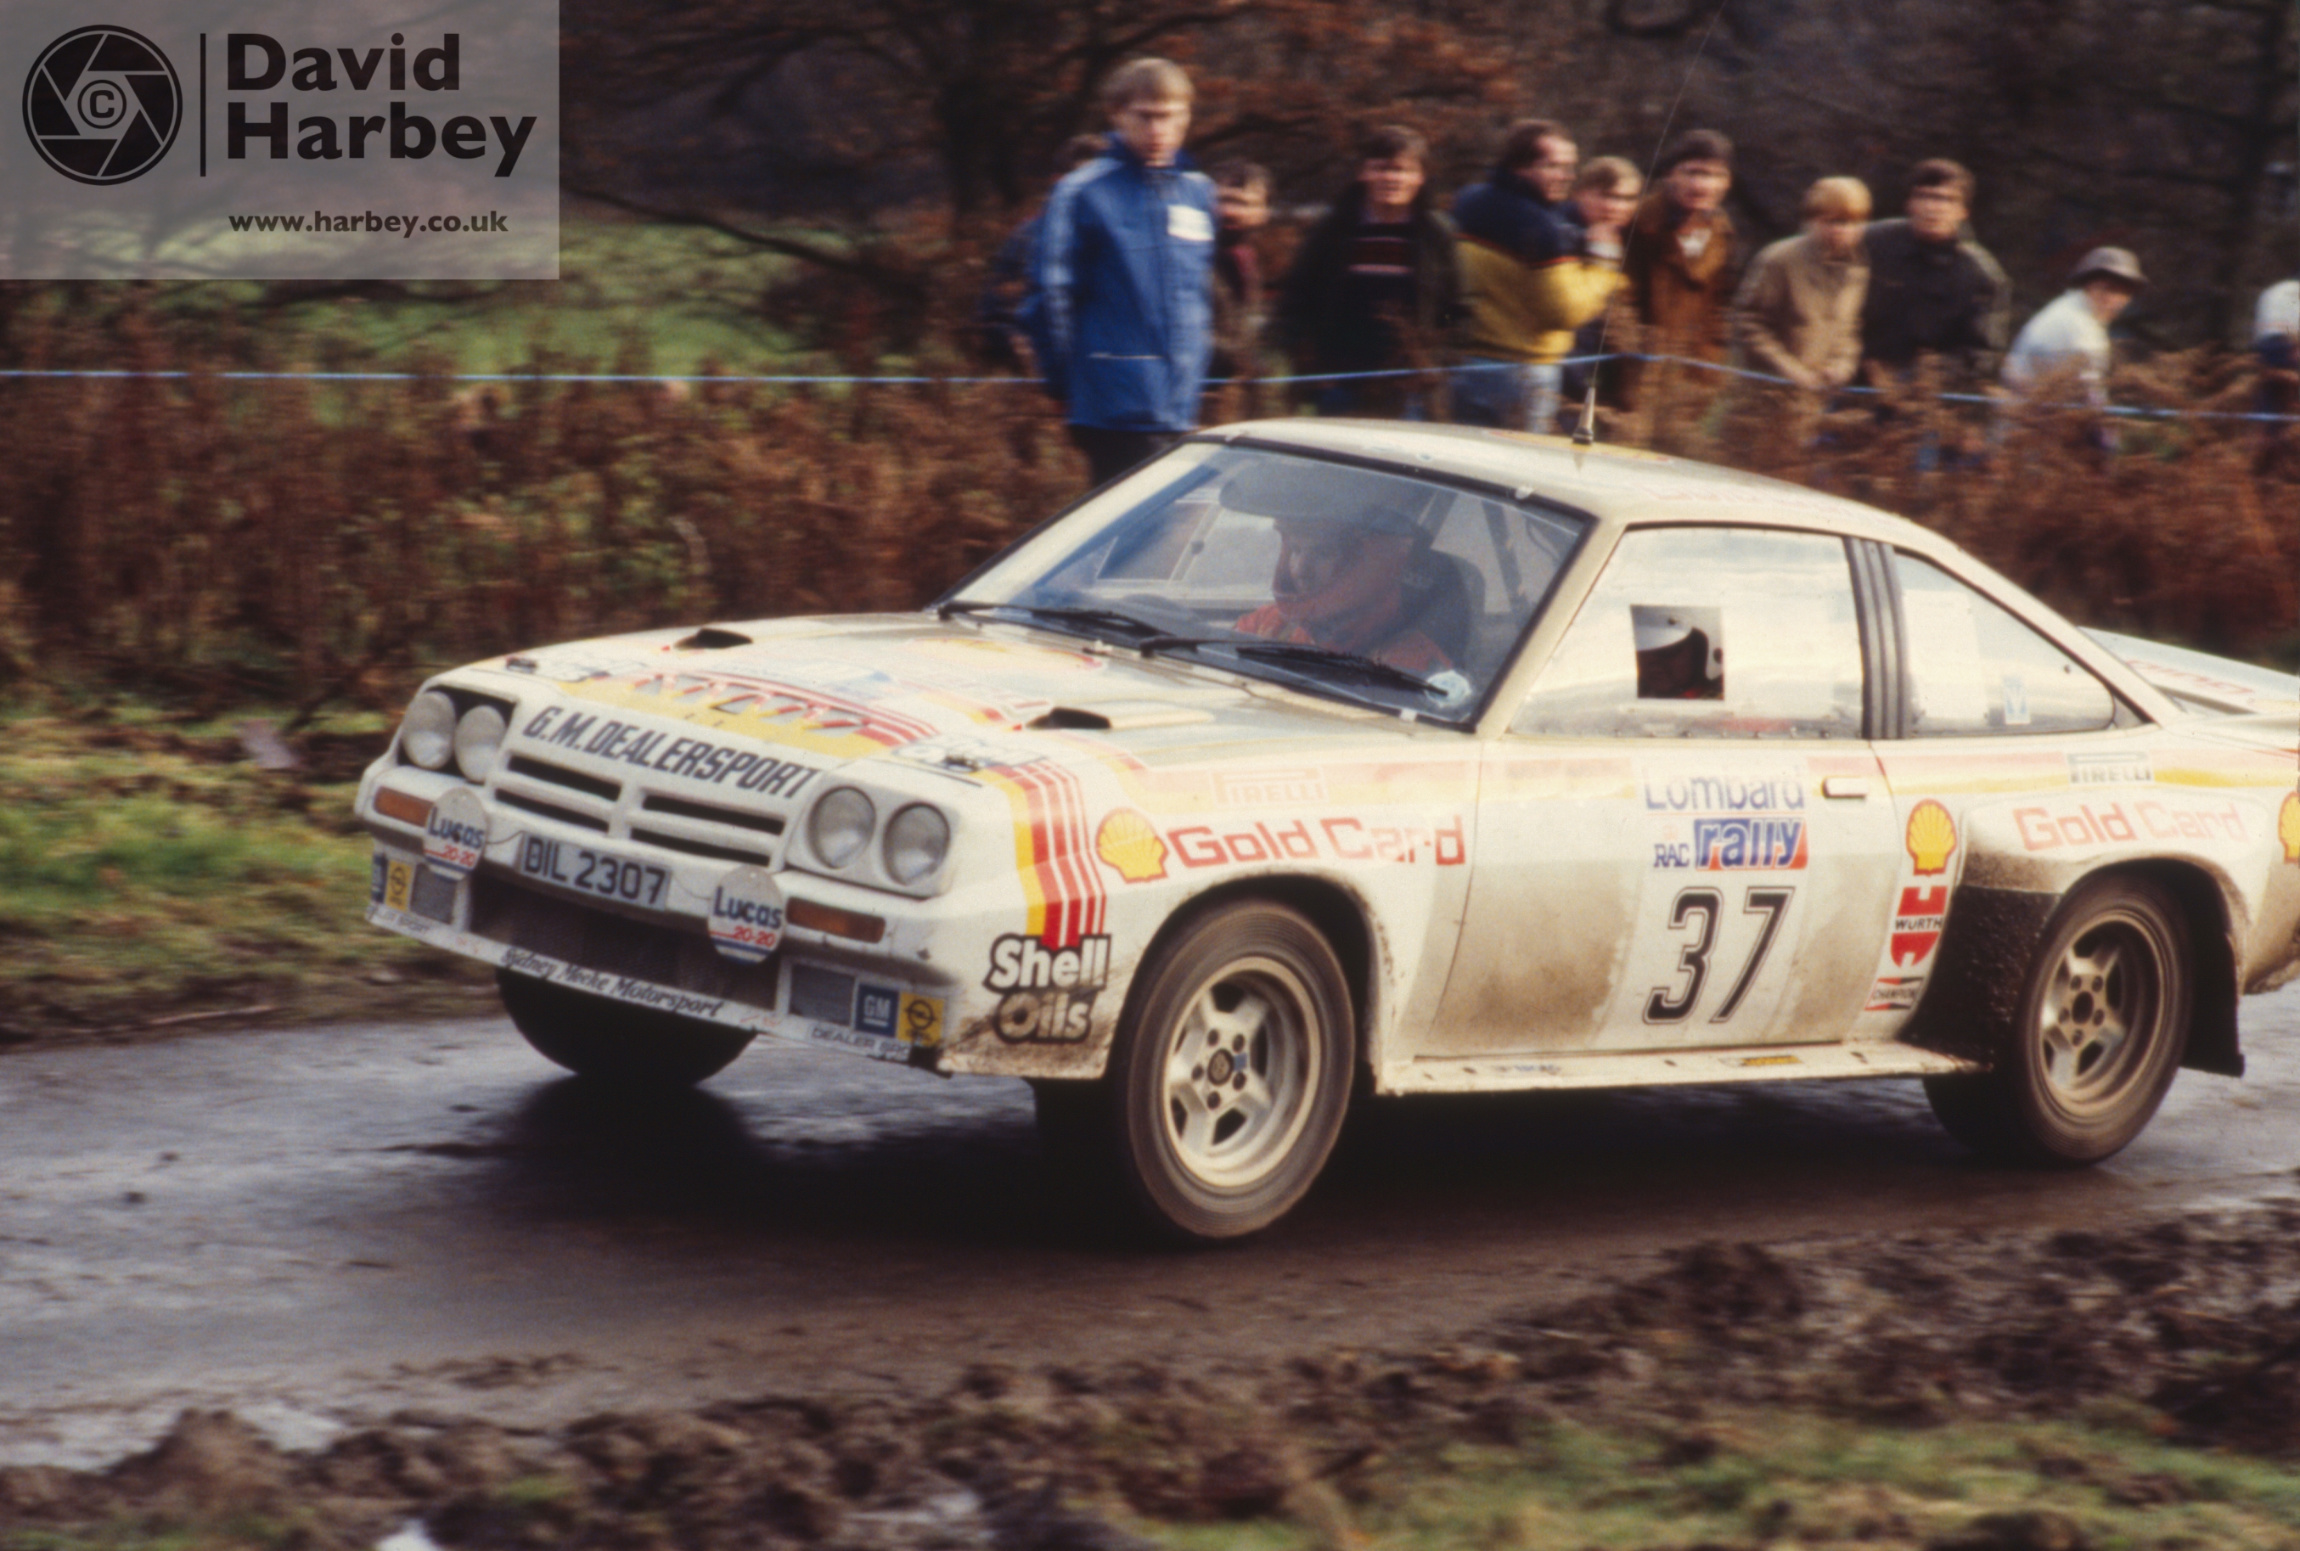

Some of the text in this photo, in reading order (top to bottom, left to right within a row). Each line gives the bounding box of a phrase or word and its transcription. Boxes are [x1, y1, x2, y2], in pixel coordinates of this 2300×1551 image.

[1211, 767, 1326, 805] PIRELLI
[1644, 765, 1805, 811] Lombard
[2067, 752, 2152, 784] PIRELLI
[427, 805, 485, 850] Lucas
[1167, 815, 1466, 869] Gold Card
[1653, 819, 1803, 870] RAC rally
[2013, 801, 2252, 851] Gold Card
[443, 844, 477, 868] 20-20
[574, 851, 666, 904] 2307
[713, 885, 783, 930] Lucas
[733, 924, 776, 948] 20-20
[1641, 885, 1797, 1026] 37
[982, 932, 1112, 995] Shell
[609, 973, 724, 1018] Motorsport
[863, 994, 891, 1018] GM
[993, 991, 1092, 1044] Oils
